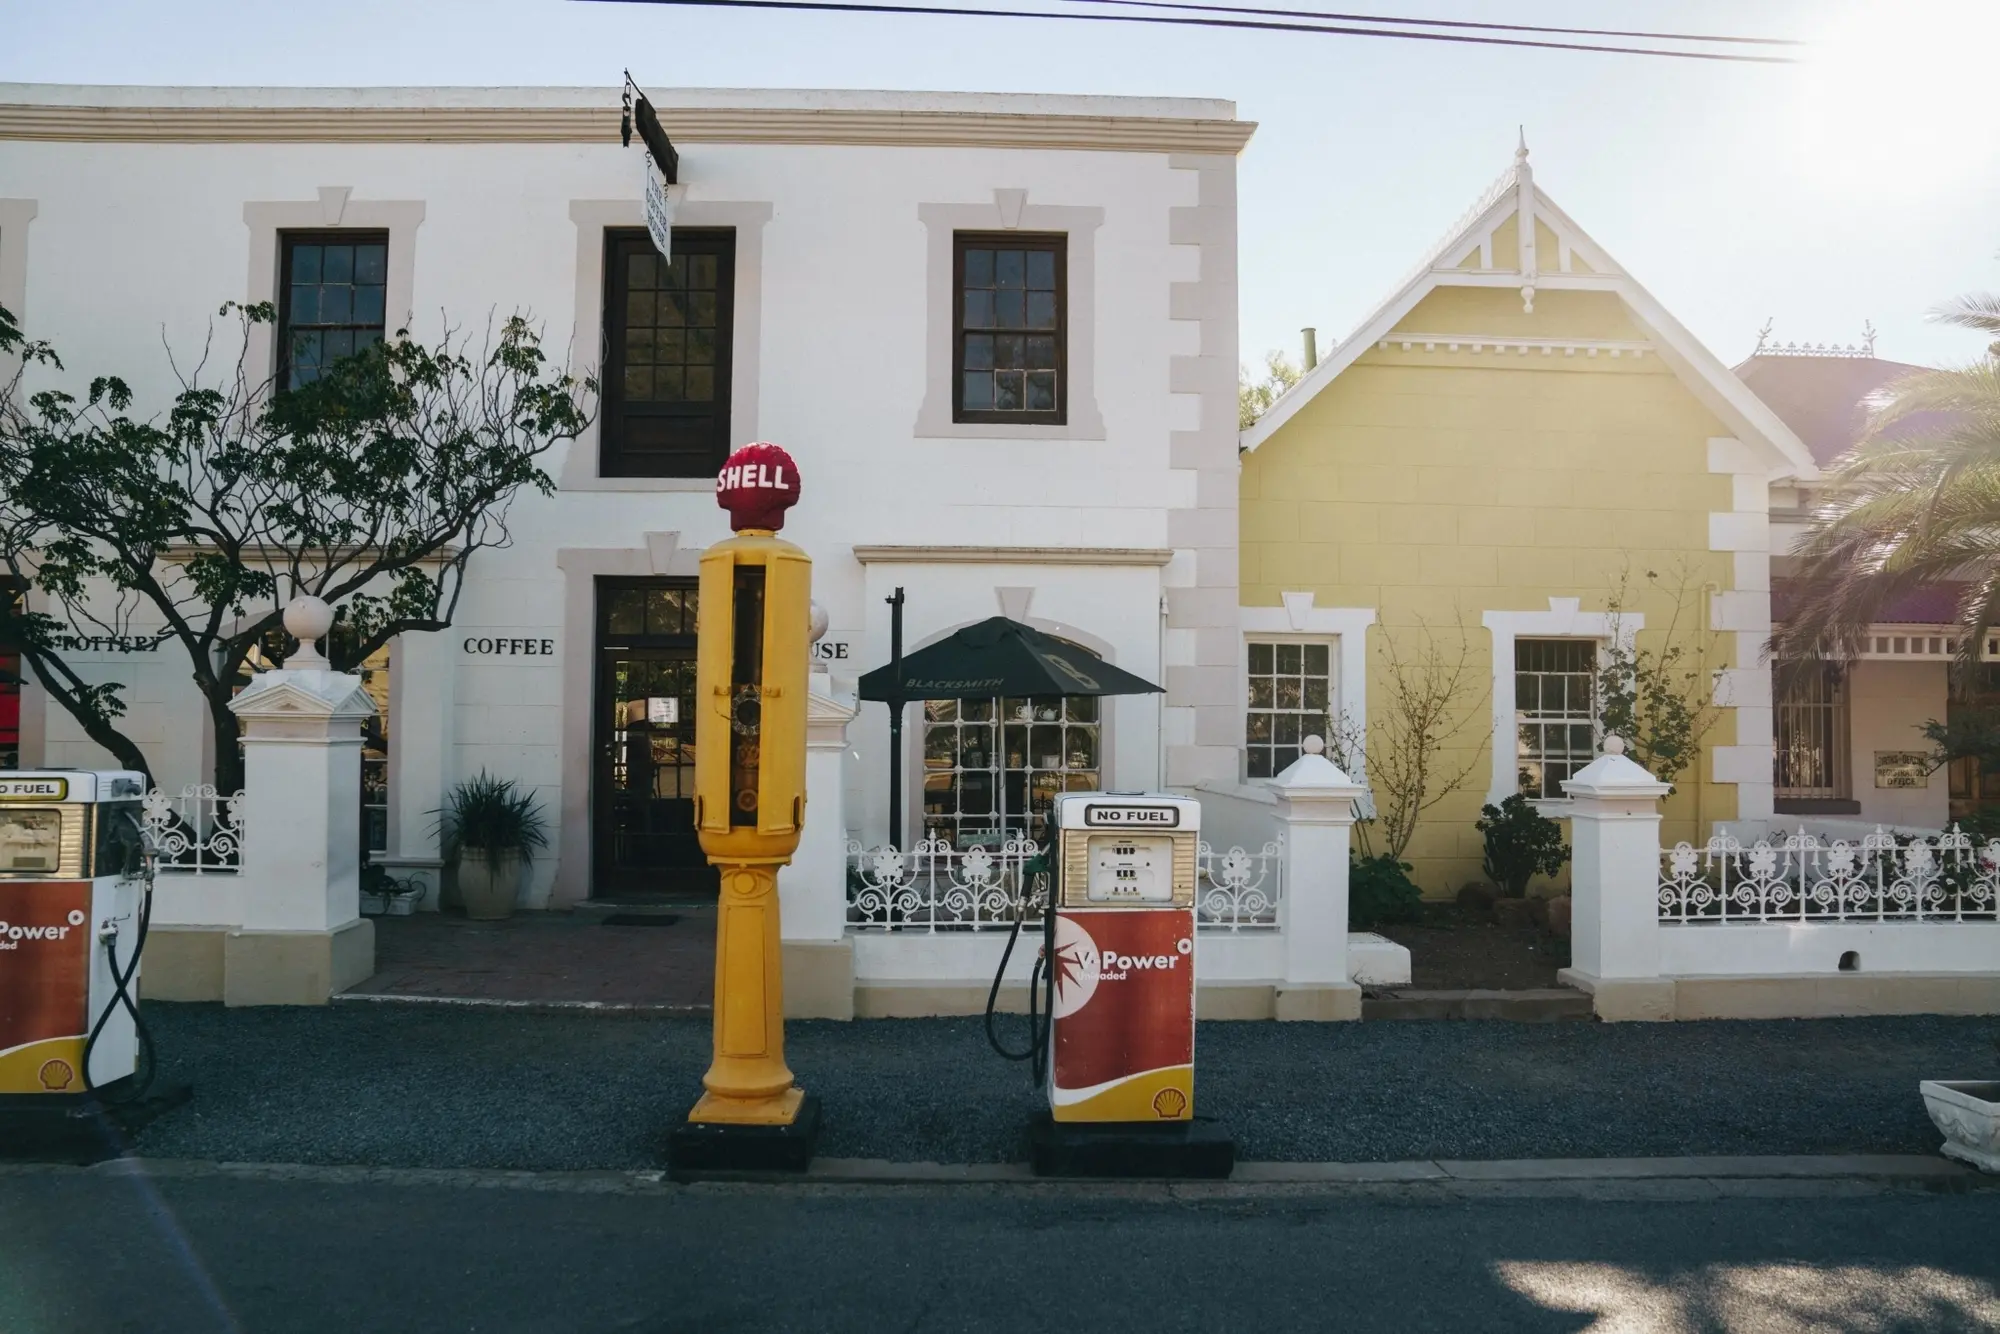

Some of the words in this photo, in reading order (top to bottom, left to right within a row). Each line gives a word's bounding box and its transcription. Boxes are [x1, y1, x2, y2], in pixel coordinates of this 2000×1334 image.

[717, 464, 789, 492] SHELL
[62, 635, 161, 652] POTTERY
[463, 637, 554, 655] COFFEE
[906, 678, 1004, 689] BLACKSMITH
[14, 784, 56, 794] FUEL
[1097, 811, 1121, 821] NO
[1127, 811, 1169, 821] FUEL
